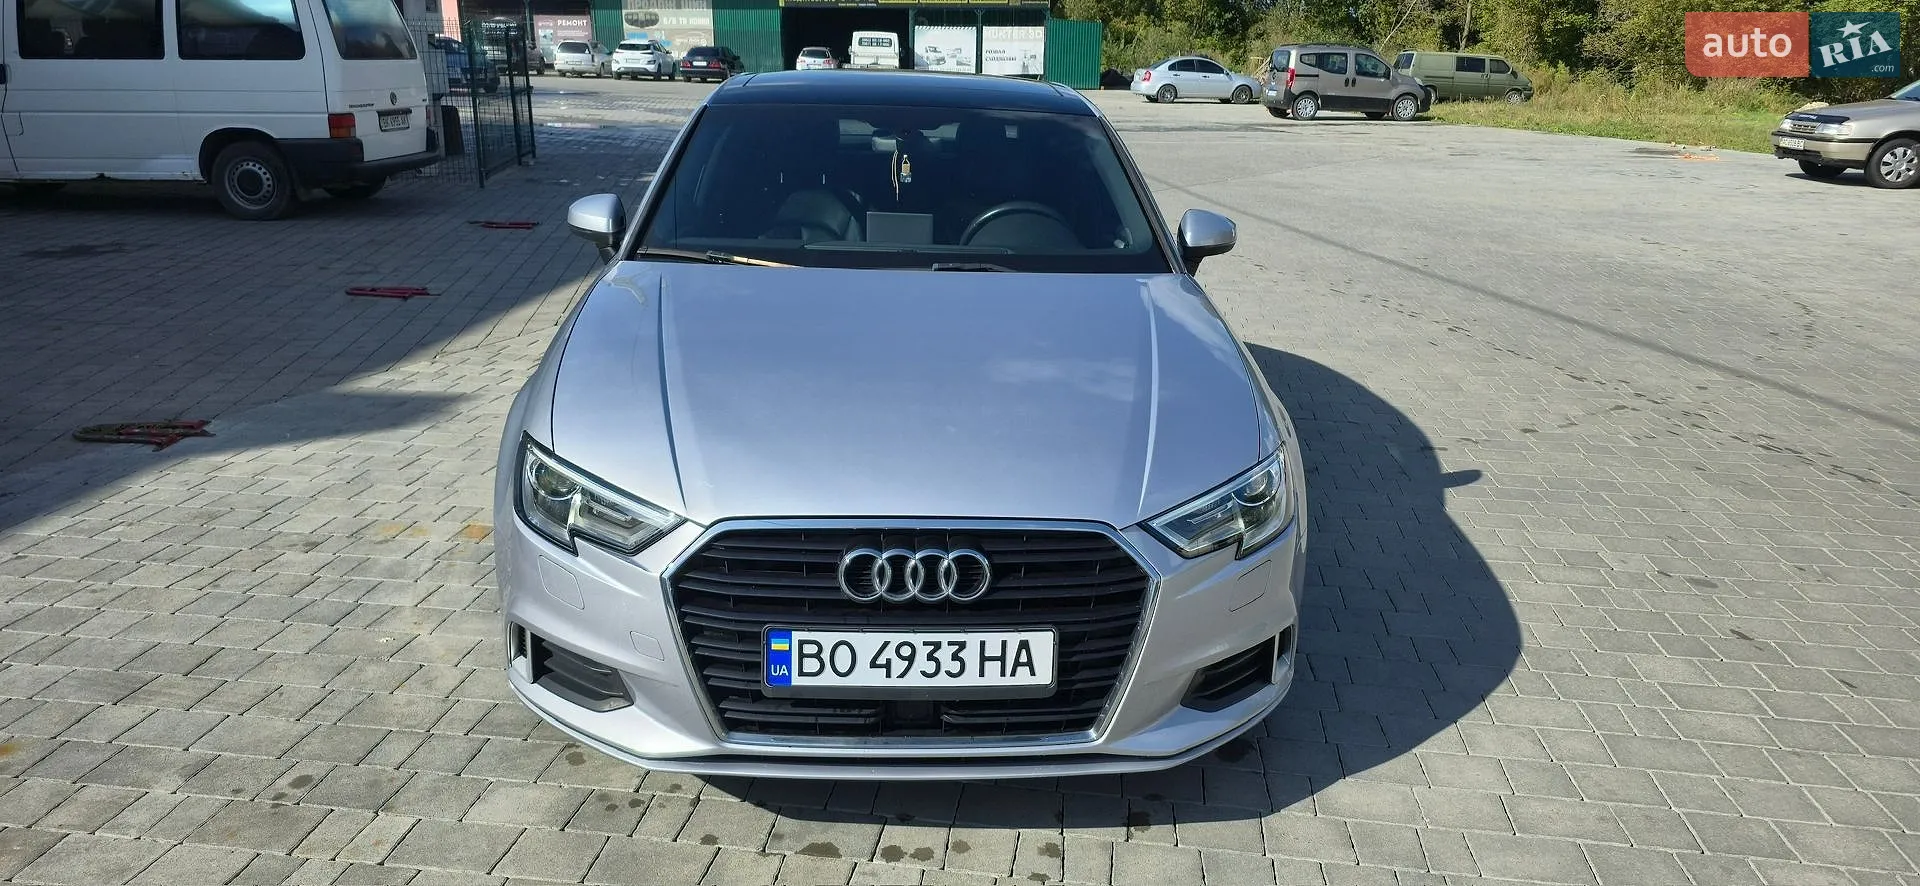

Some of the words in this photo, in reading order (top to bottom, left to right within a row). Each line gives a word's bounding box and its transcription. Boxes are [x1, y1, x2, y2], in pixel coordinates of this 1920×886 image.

[771, 664, 789, 676] UA
[797, 639, 857, 678] BO
[869, 640, 967, 679] 4933
[978, 639, 1036, 678] HA
